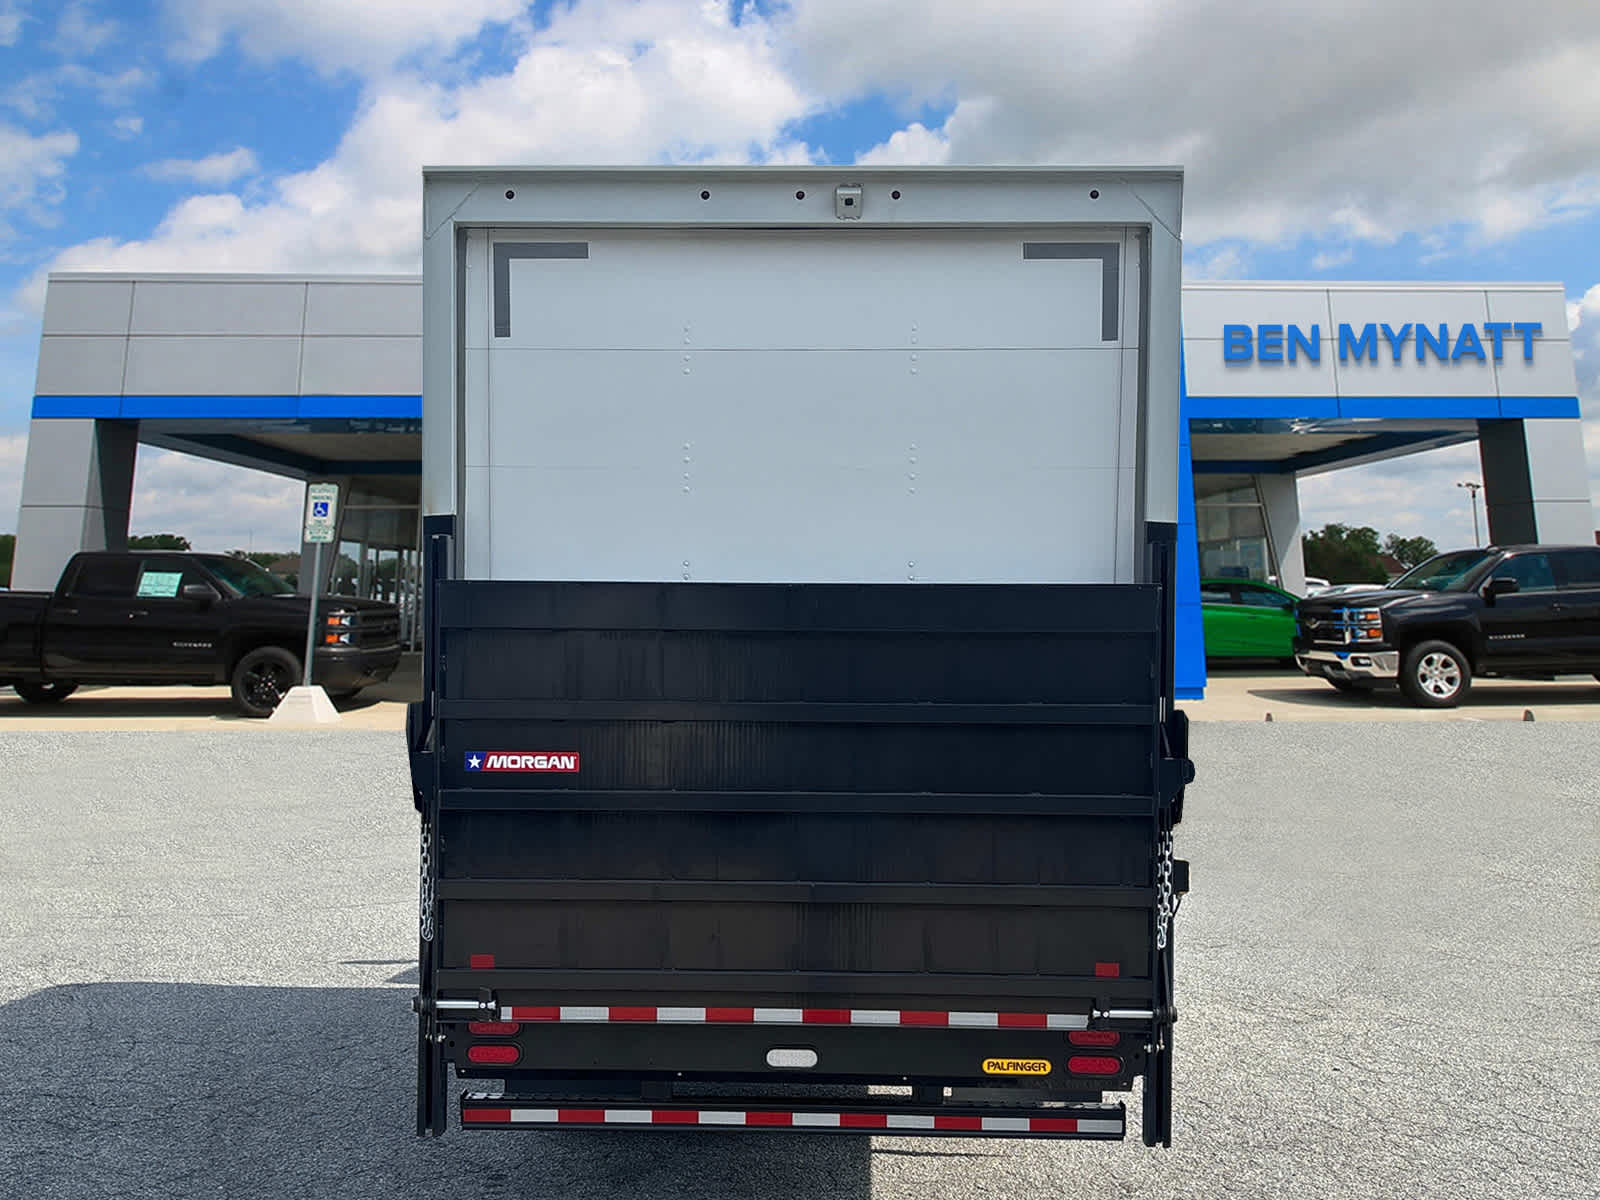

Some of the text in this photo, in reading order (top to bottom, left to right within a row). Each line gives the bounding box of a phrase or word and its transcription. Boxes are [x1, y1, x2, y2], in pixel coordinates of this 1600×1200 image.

[1223, 322, 1542, 362] BEN MYNATT
[486, 755, 575, 769] MORGAN
[986, 1061, 1047, 1072] PALFINGER
